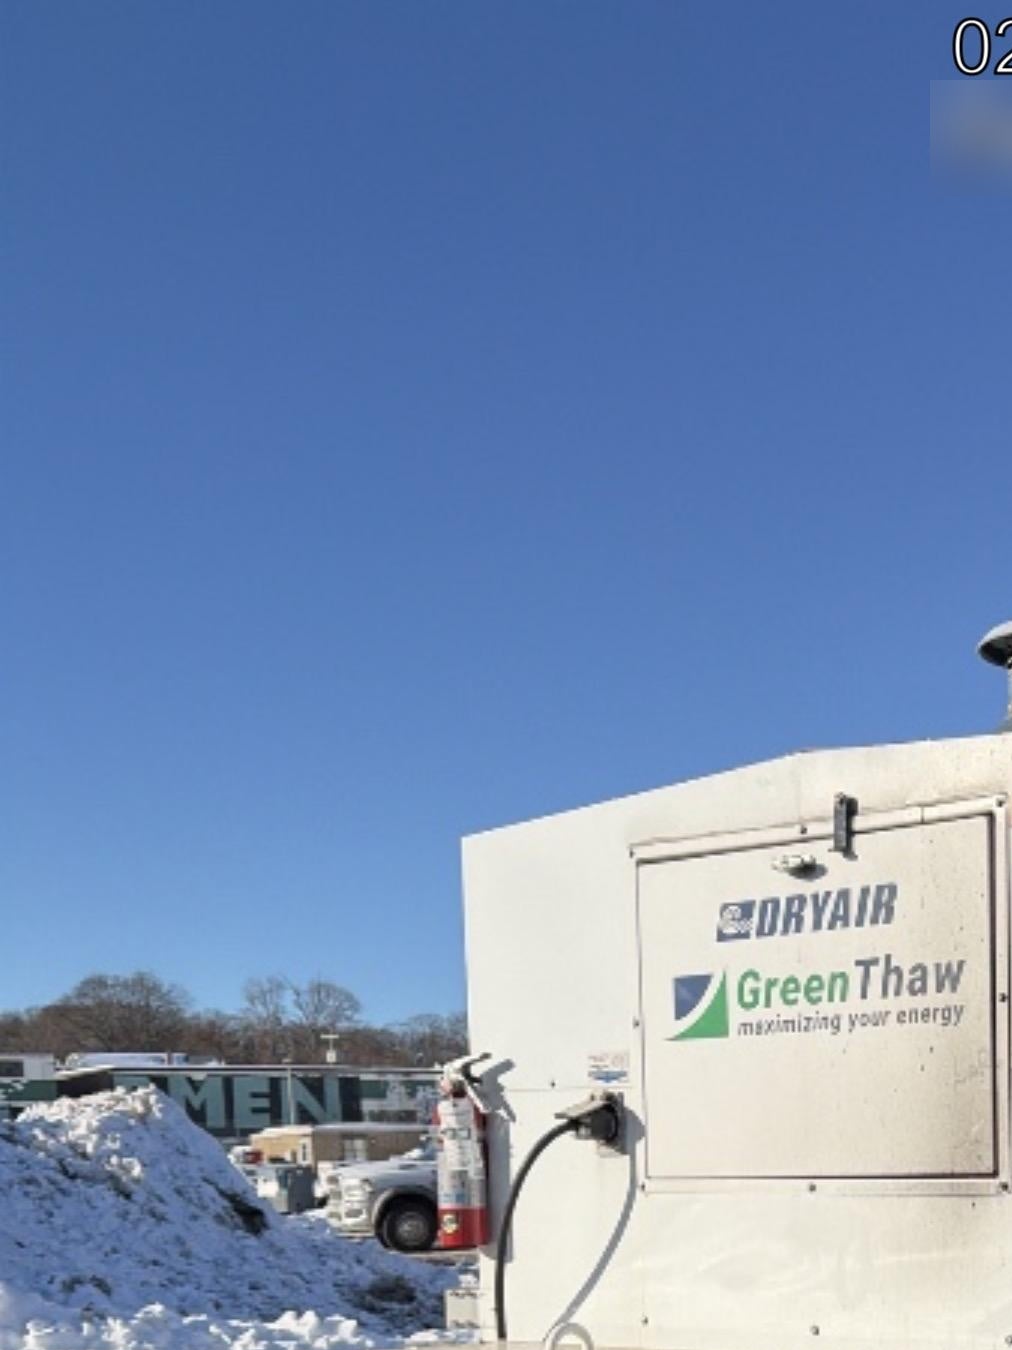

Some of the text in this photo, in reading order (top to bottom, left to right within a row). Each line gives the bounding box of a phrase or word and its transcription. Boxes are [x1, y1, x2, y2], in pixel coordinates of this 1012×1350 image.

[756, 883, 898, 938] DRYAIR
[737, 1004, 965, 1036] maximizing your energy
[113, 1071, 341, 1129] MEN
